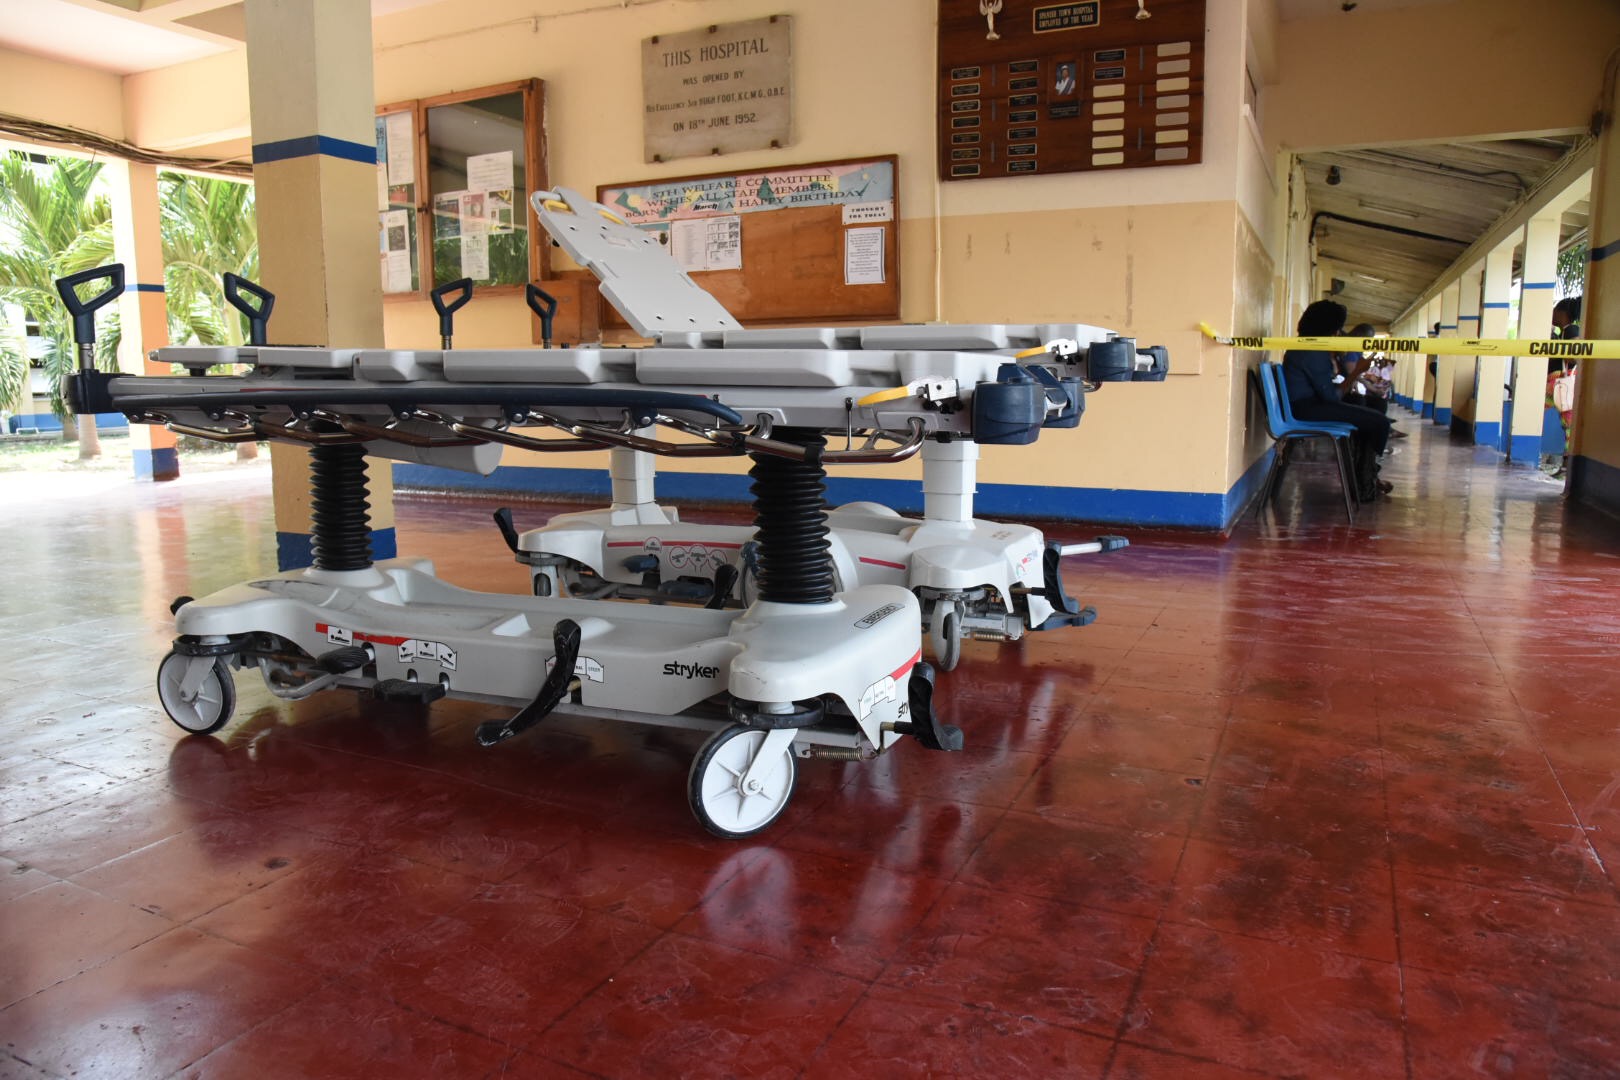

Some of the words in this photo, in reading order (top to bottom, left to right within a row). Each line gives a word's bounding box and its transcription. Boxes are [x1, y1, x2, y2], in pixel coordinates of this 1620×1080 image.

[662, 49, 691, 68] THIS
[700, 37, 769, 62] HOSPITAL
[683, 76, 698, 85] WAS
[702, 72, 729, 84] OPENED
[734, 70, 745, 79] BY
[673, 121, 685, 133] ON
[708, 115, 730, 128] JUNE
[647, 196, 692, 207] WISHES
[697, 192, 721, 202] ALL
[771, 182, 834, 195] MEMBERS
[653, 188, 678, 199] STH
[682, 180, 741, 193] WELFARE
[746, 174, 831, 187] COMMITTEE
[625, 209, 660, 218] BORN
[664, 205, 679, 214] IN
[726, 201, 734, 209] A
[740, 196, 785, 208] HAPPY
[791, 190, 864, 203] BIRTHDAY
[1362, 339, 1420, 352] CAUTION
[1529, 342, 1594, 356] CAUTION
[663, 660, 720, 679] stryker
